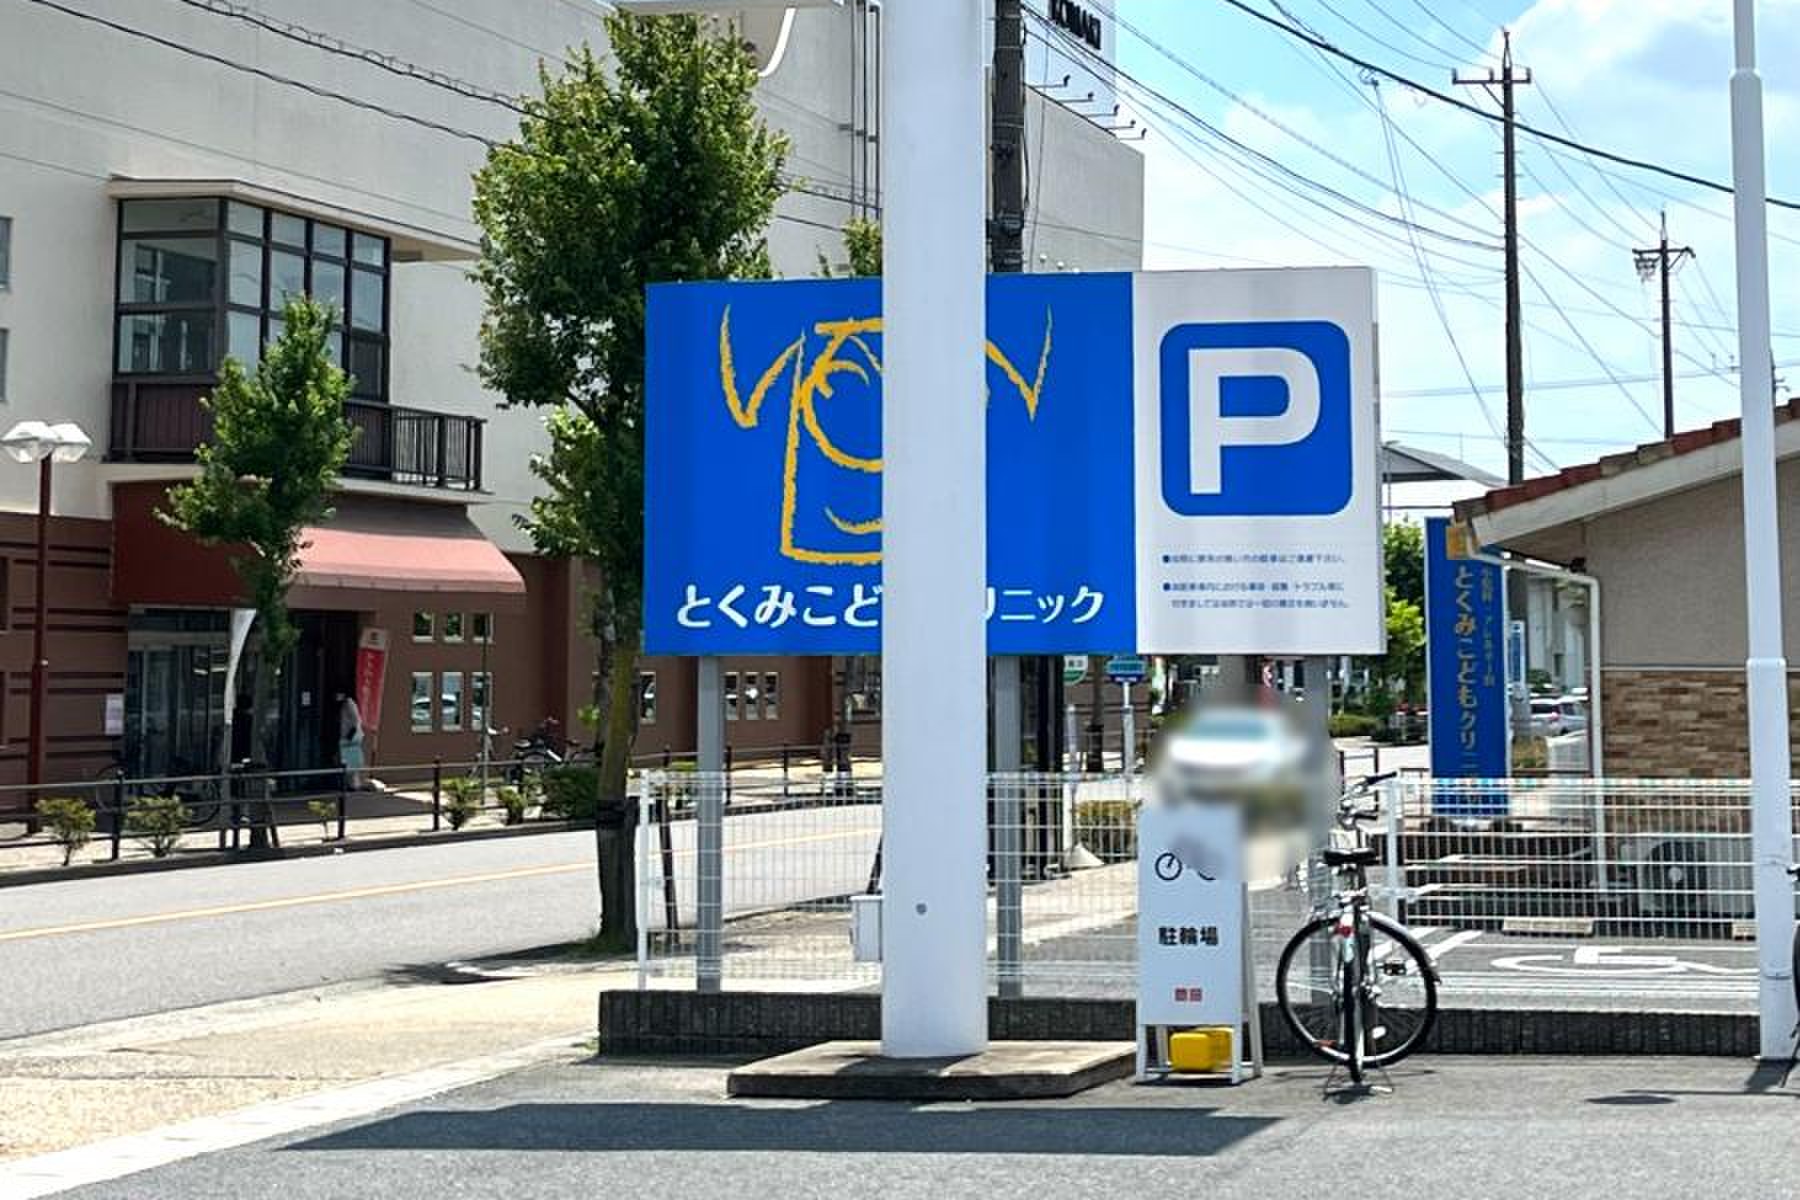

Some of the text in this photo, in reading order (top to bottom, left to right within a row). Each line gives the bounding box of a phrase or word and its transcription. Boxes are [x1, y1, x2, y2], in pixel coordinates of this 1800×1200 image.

[1188, 347, 1322, 496] P
[1158, 926, 1219, 947] 駐輪場
